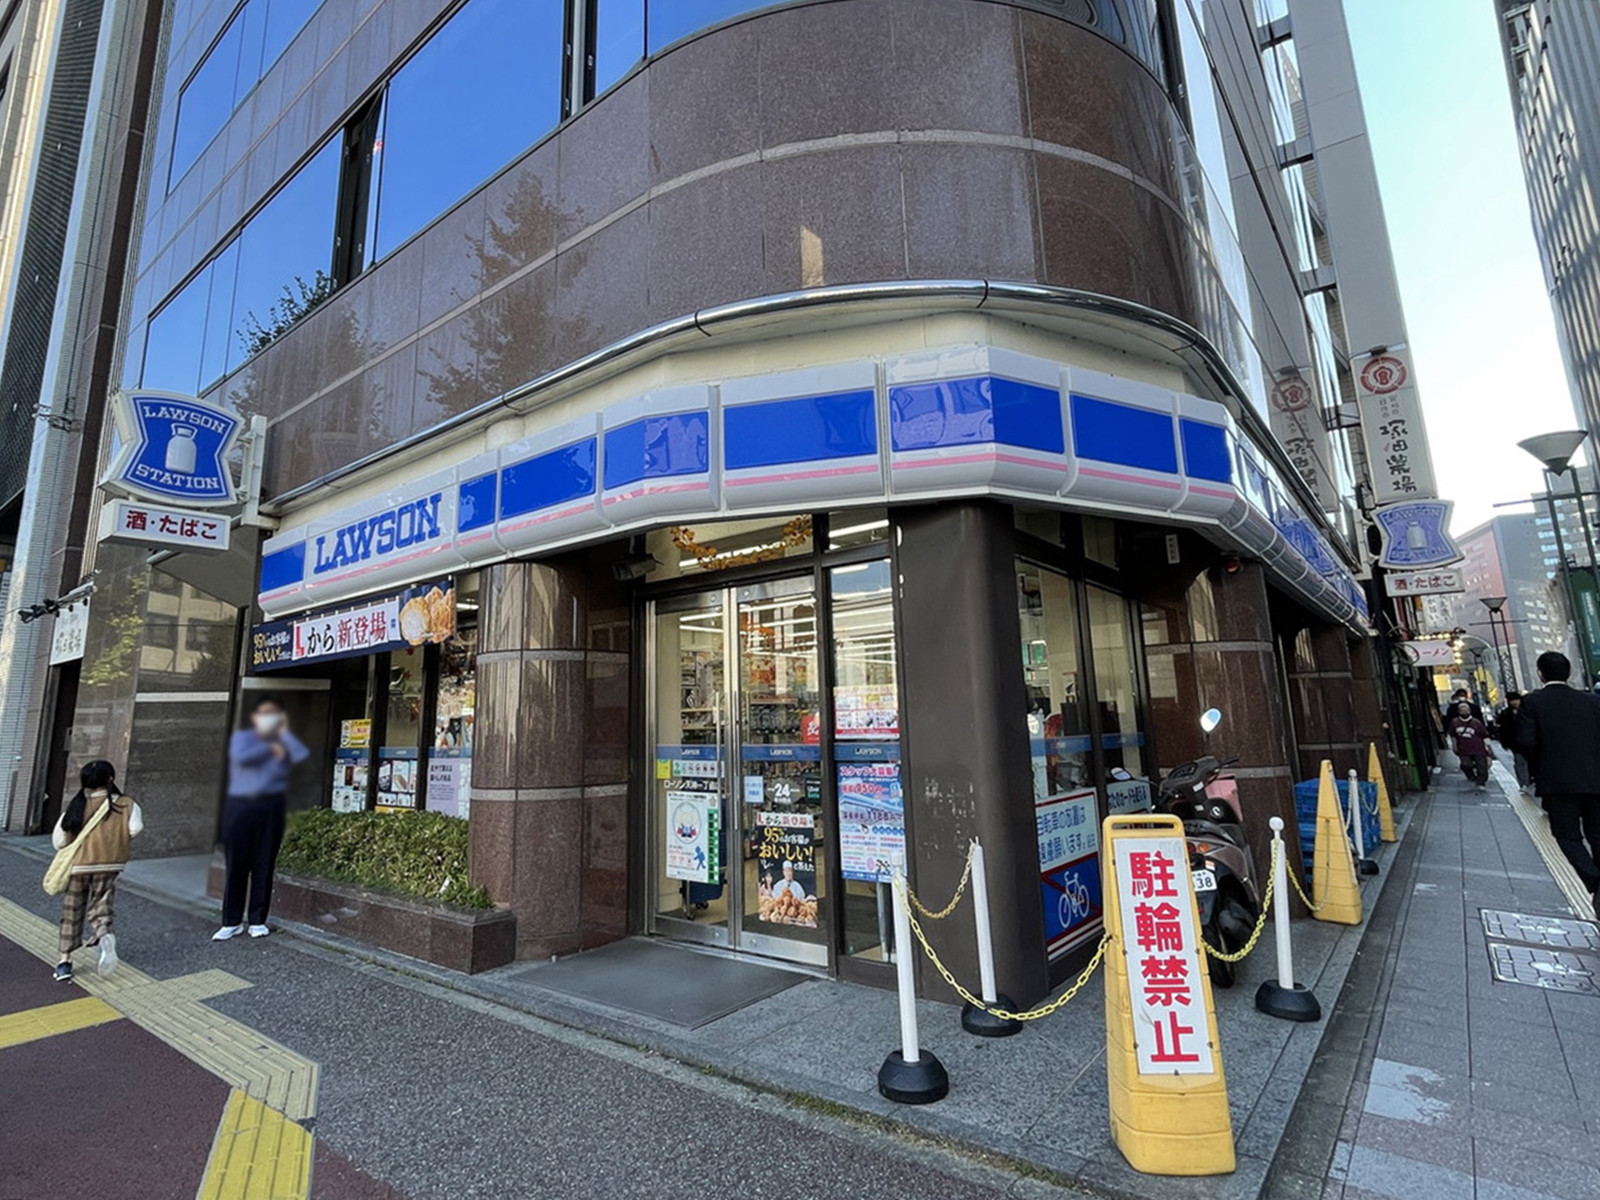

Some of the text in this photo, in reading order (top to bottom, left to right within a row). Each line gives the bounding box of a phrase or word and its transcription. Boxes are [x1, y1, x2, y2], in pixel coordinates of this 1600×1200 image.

[143, 405, 226, 435] LAWSON
[135, 463, 220, 490] STATION
[126, 509, 218, 540] 酒・たばこ
[313, 492, 443, 575] LAWSON
[774, 782, 791, 797] 24
[759, 842, 813, 862] おいしい!
[1192, 876, 1214, 888] 38
[1129, 850, 1200, 1062] 駐輪禁止
